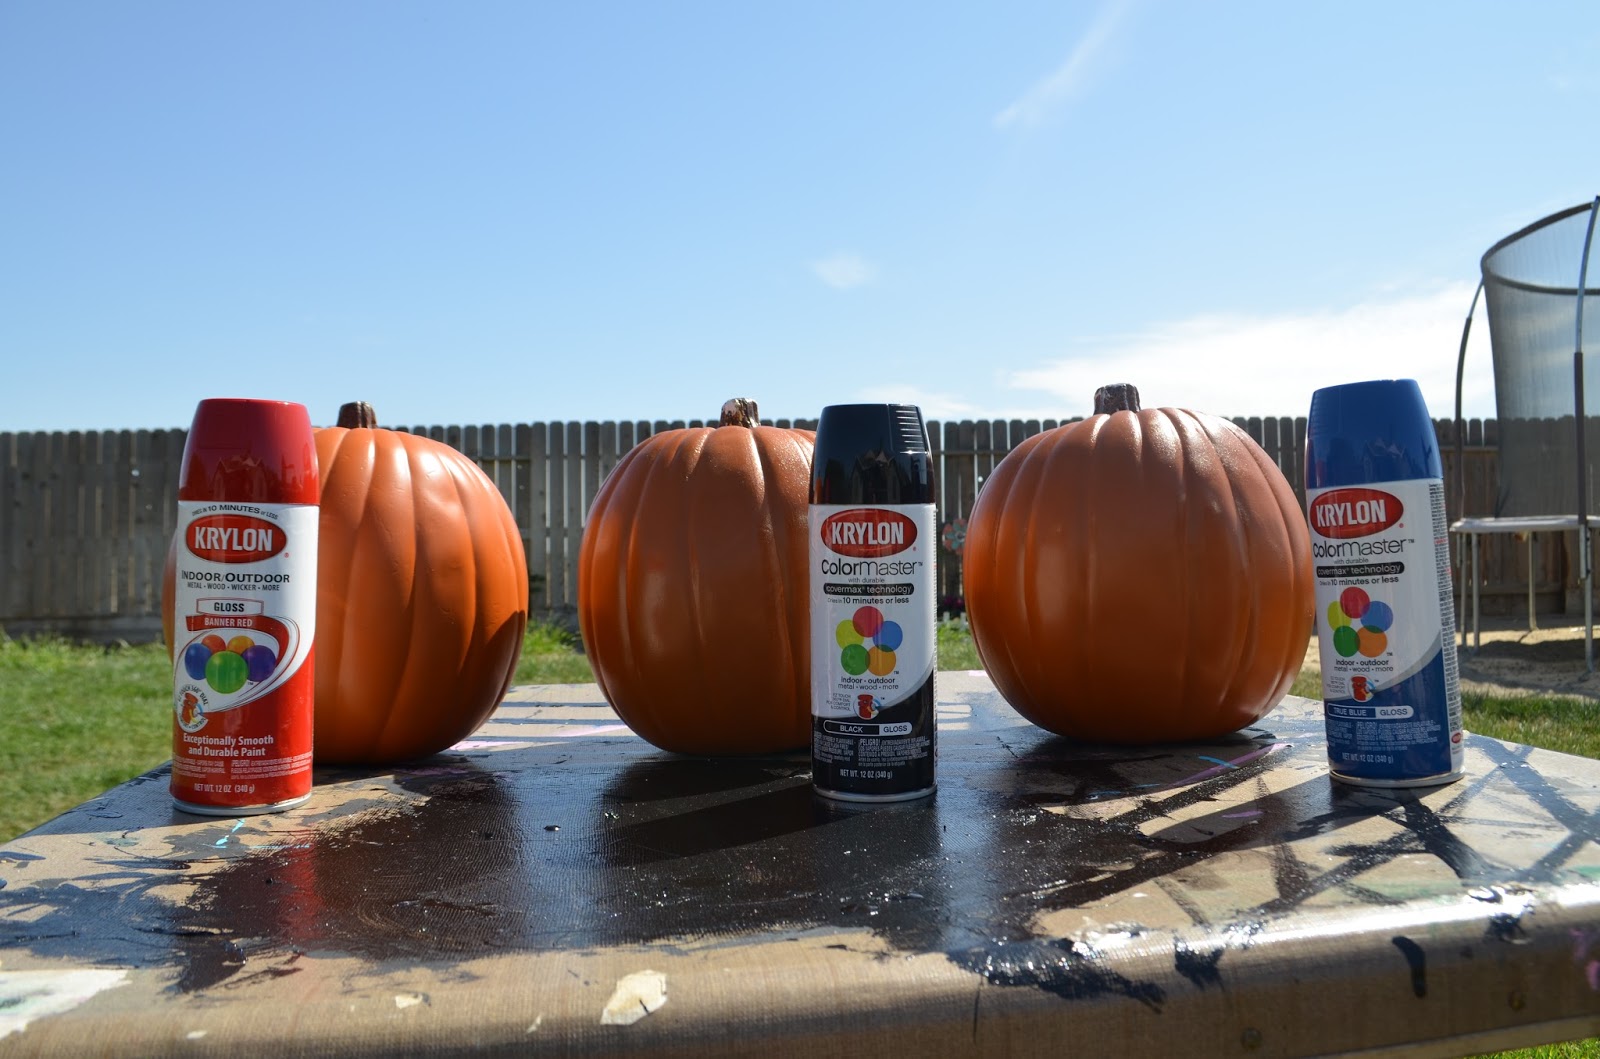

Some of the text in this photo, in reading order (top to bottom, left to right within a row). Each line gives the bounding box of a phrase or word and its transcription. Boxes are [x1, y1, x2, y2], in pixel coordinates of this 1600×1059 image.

[219, 504, 260, 514] MINUTES
[266, 512, 279, 520] LESS
[1316, 499, 1386, 528] KRYLON
[831, 522, 904, 545] KRYLON
[194, 526, 273, 552] KRYLON
[821, 558, 918, 576] Colormaster
[1351, 563, 1401, 574] technology
[1339, 578, 1370, 586] minutes
[262, 584, 280, 592] MORE
[866, 586, 912, 595] technology
[894, 596, 910, 604] less
[214, 602, 244, 612] GLOSS
[204, 617, 253, 628] BANNER RED
[1334, 707, 1348, 715] TRUE
[1349, 708, 1367, 716] BLUE
[840, 724, 908, 733] BLACK GLOSS
[183, 732, 274, 748] Exceptionally Smooth
[188, 746, 266, 757] and Durable Paint
[1360, 754, 1366, 762] 12
[1367, 754, 1374, 763] OZ
[860, 770, 866, 778] 12
[194, 783, 204, 792] NET
[215, 784, 222, 792] 12
[224, 784, 232, 792] OZ
